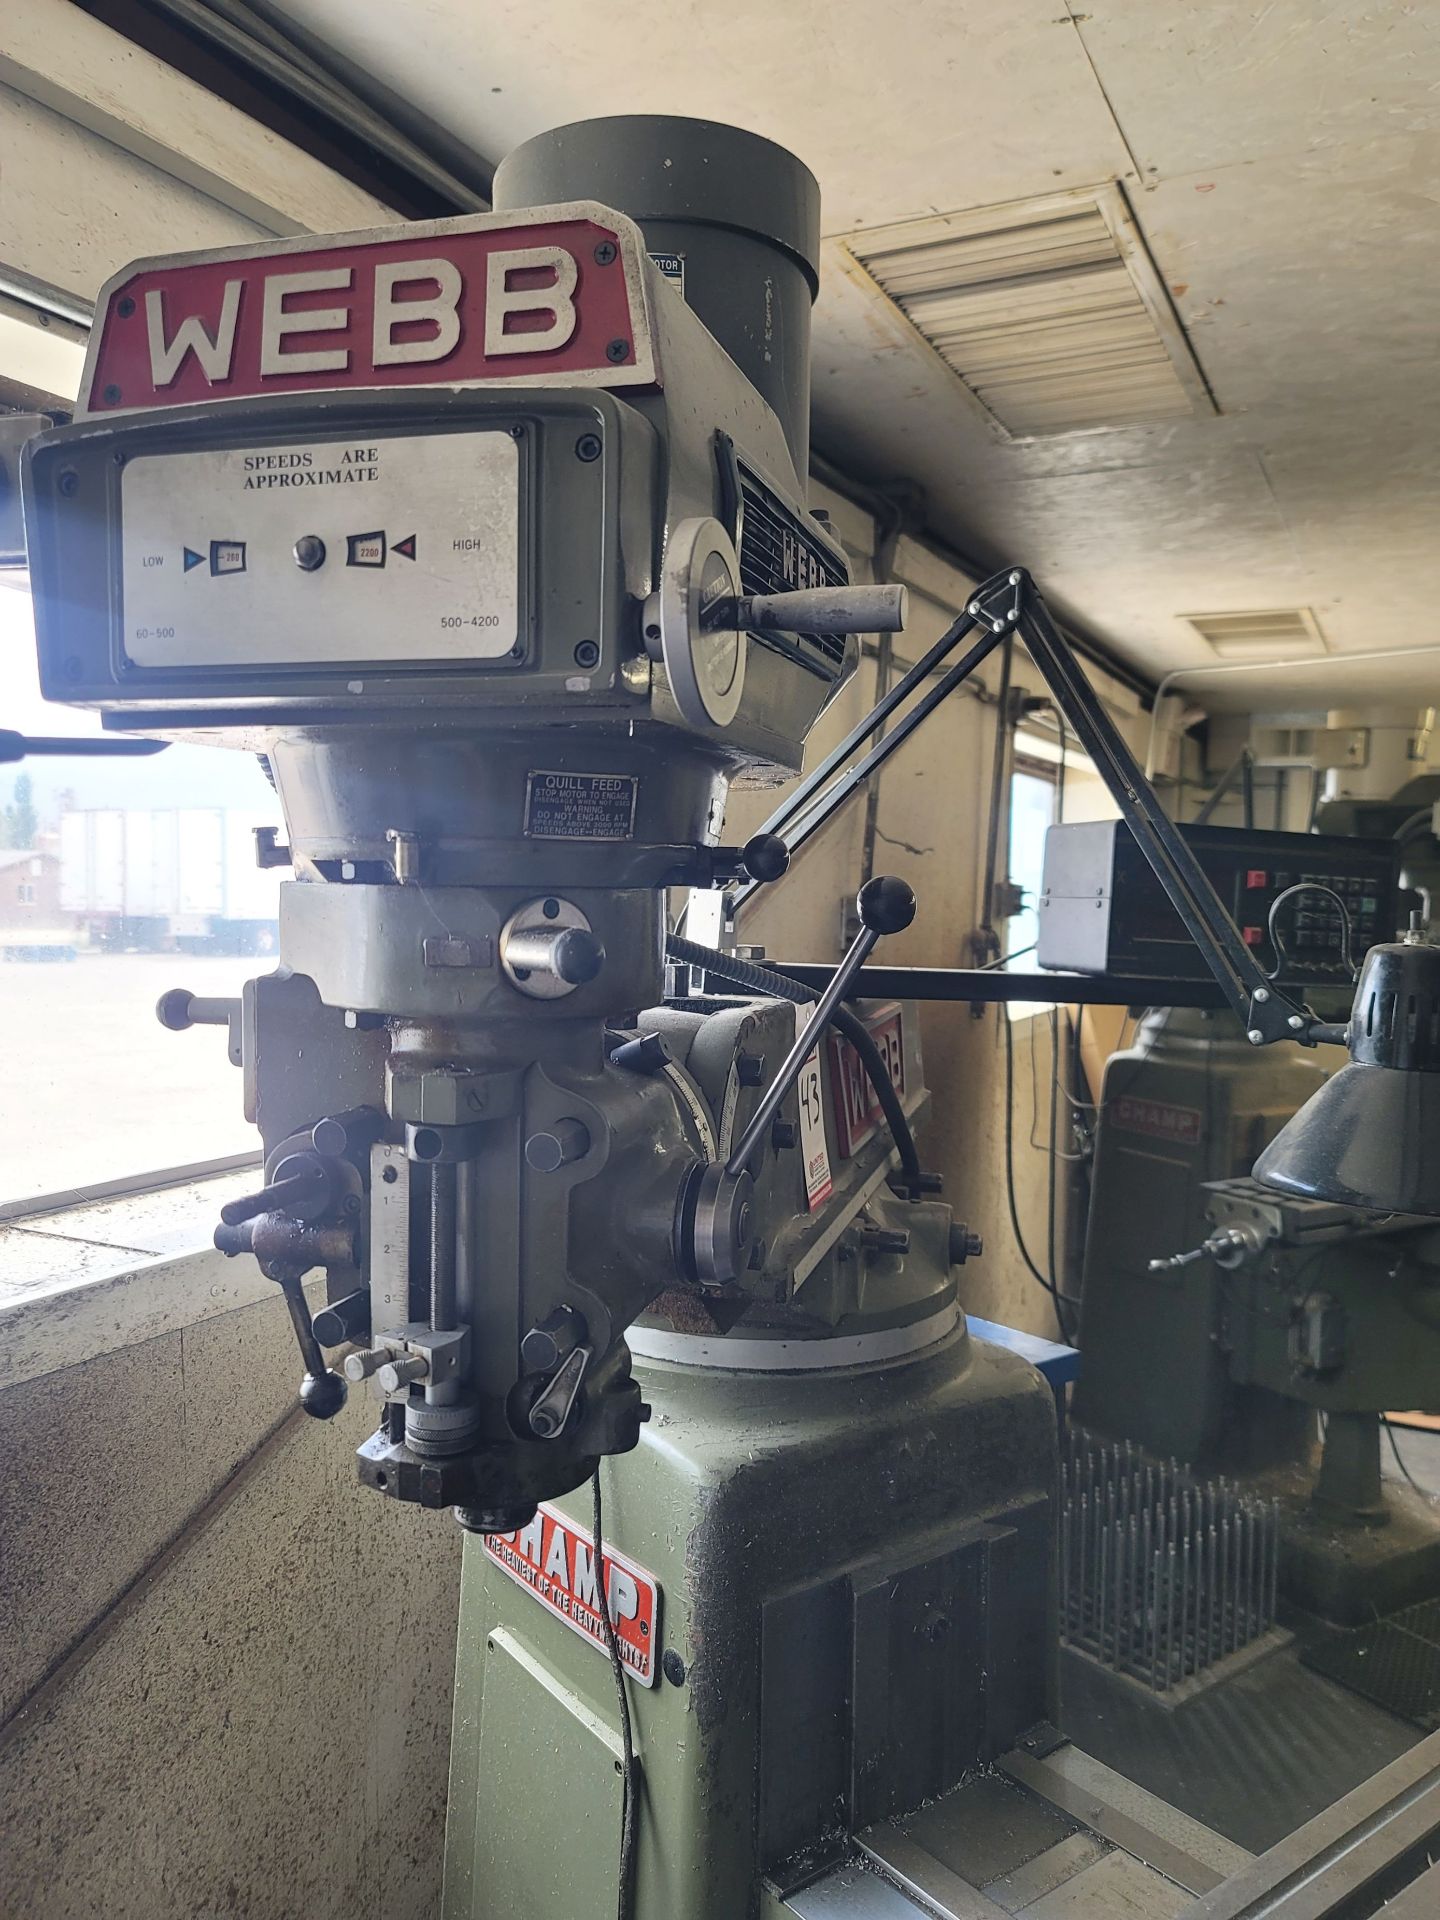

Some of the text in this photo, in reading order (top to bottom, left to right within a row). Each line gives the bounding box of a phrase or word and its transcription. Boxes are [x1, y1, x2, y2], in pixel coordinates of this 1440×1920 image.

[654, 259, 678, 270] OTOR
[145, 246, 578, 387] WEBB
[244, 448, 379, 471] SPEEDS ARE
[243, 467, 379, 490] APPROXIMATE
[453, 539, 481, 550] HIGH
[360, 547, 379, 557] 2200
[142, 556, 164, 567] LOW
[441, 616, 500, 629] 500-4200
[136, 627, 175, 639] 60-500
[546, 776, 622, 791] QUILL FEED
[535, 788, 630, 800] STOP MOTOR TO ENGAGE
[564, 805, 604, 814] WARNING
[537, 810, 550, 819] DO
[554, 811, 572, 820] NOT
[577, 813, 611, 821] ENGAGE
[568, 820, 591, 828] ABOVE
[801, 1072, 820, 1131] 43
[384, 1197, 388, 1205] 1
[384, 1245, 390, 1254] 2
[384, 1294, 391, 1304] 3
[487, 1533, 502, 1557] THE
[501, 1542, 538, 1585] HEAVIEST
[538, 1575, 550, 1596] OF
[552, 1584, 570, 1613] THE
